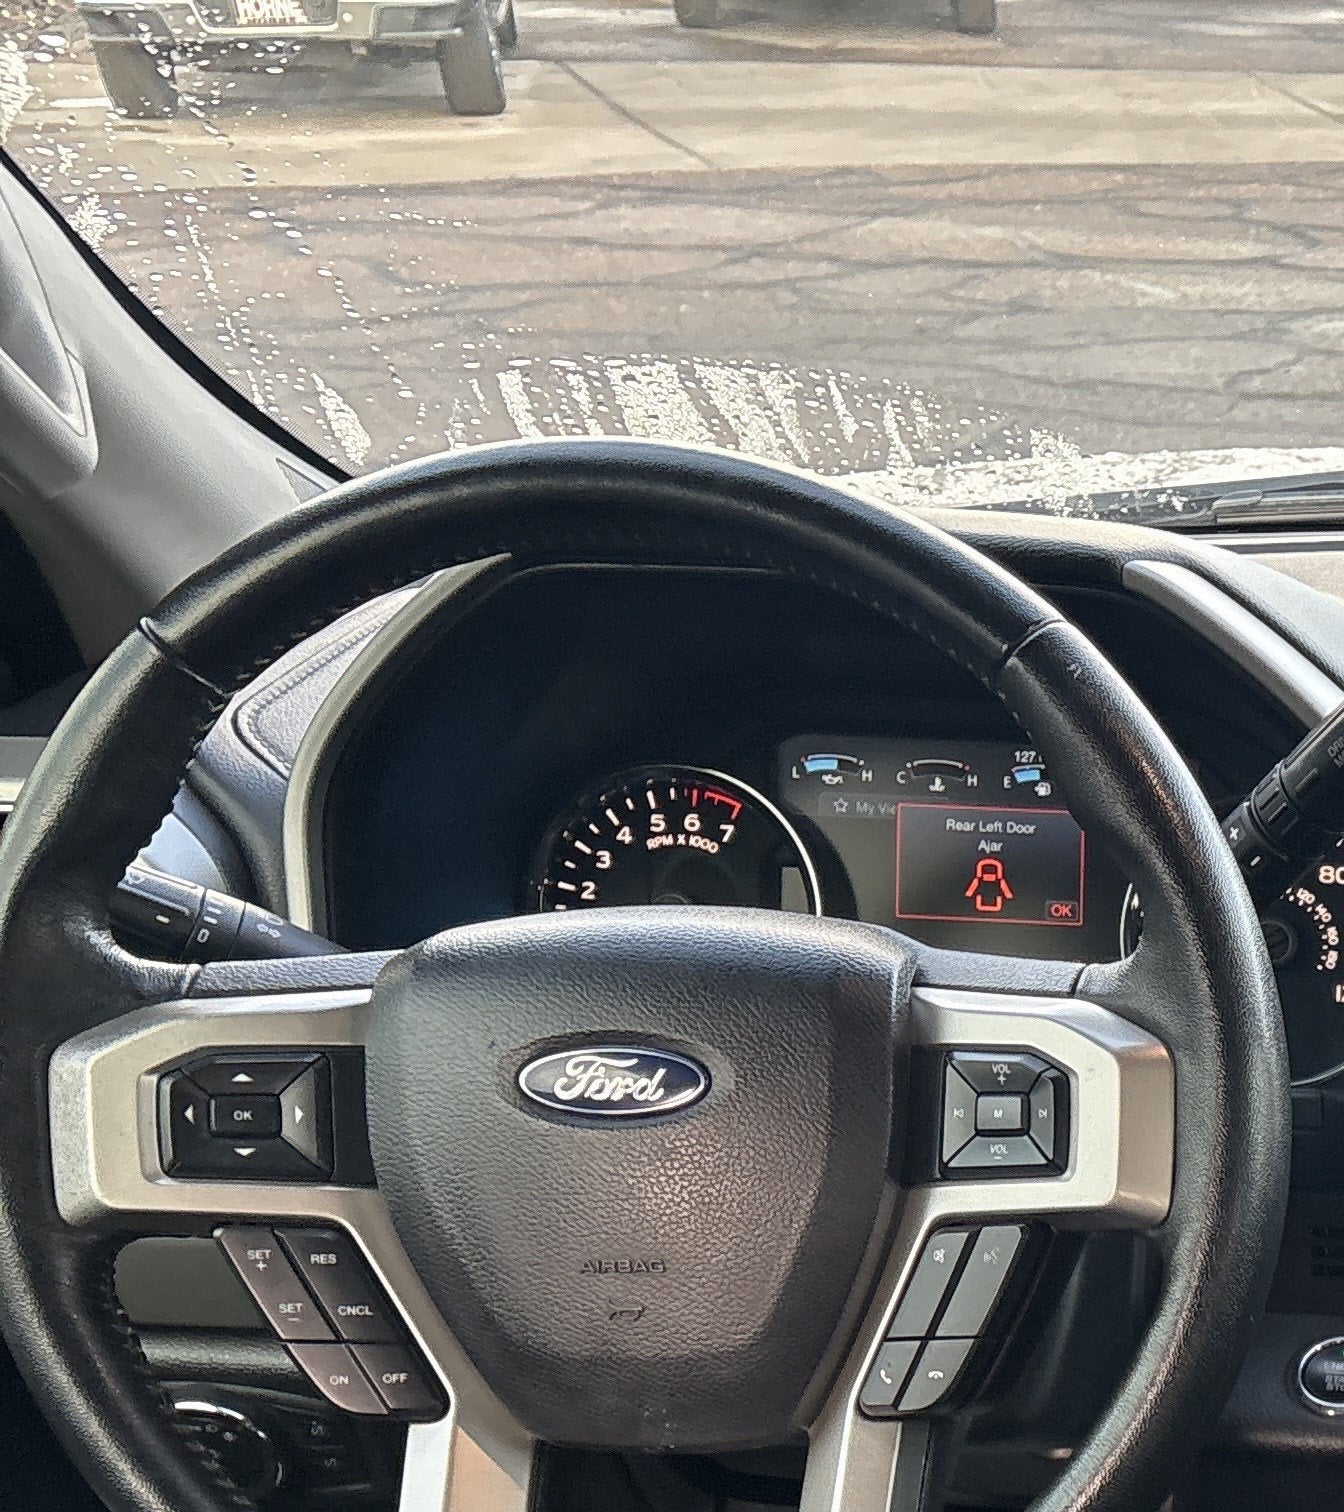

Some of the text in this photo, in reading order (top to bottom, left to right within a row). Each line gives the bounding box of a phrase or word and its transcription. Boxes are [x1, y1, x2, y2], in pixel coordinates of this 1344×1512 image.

[861, 770, 873, 783] H
[896, 772, 906, 785] C
[967, 774, 978, 787] H
[1003, 776, 1012, 789] E
[650, 813, 666, 832] 5
[683, 813, 701, 832] 6
[945, 818, 1037, 835] Rear Left Door
[615, 826, 633, 845] 4
[719, 823, 735, 843] 7
[646, 834, 674, 851] RPM
[688, 835, 720, 855] 1000
[977, 840, 1003, 855] Ajar
[595, 850, 612, 869] 3
[580, 881, 597, 900] 2
[1050, 903, 1073, 918] OK
[991, 1063, 1011, 1075] VOL
[553, 1054, 667, 1101] Ford
[233, 1110, 253, 1121] OK
[989, 1144, 1008, 1155] VOL
[247, 1250, 272, 1261] SET
[310, 1253, 337, 1265] RES
[580, 1259, 667, 1275] AIRBAG
[278, 1303, 304, 1314] SET
[337, 1305, 373, 1316] CNCL
[329, 1375, 349, 1386] ON
[382, 1373, 408, 1385] OFF
